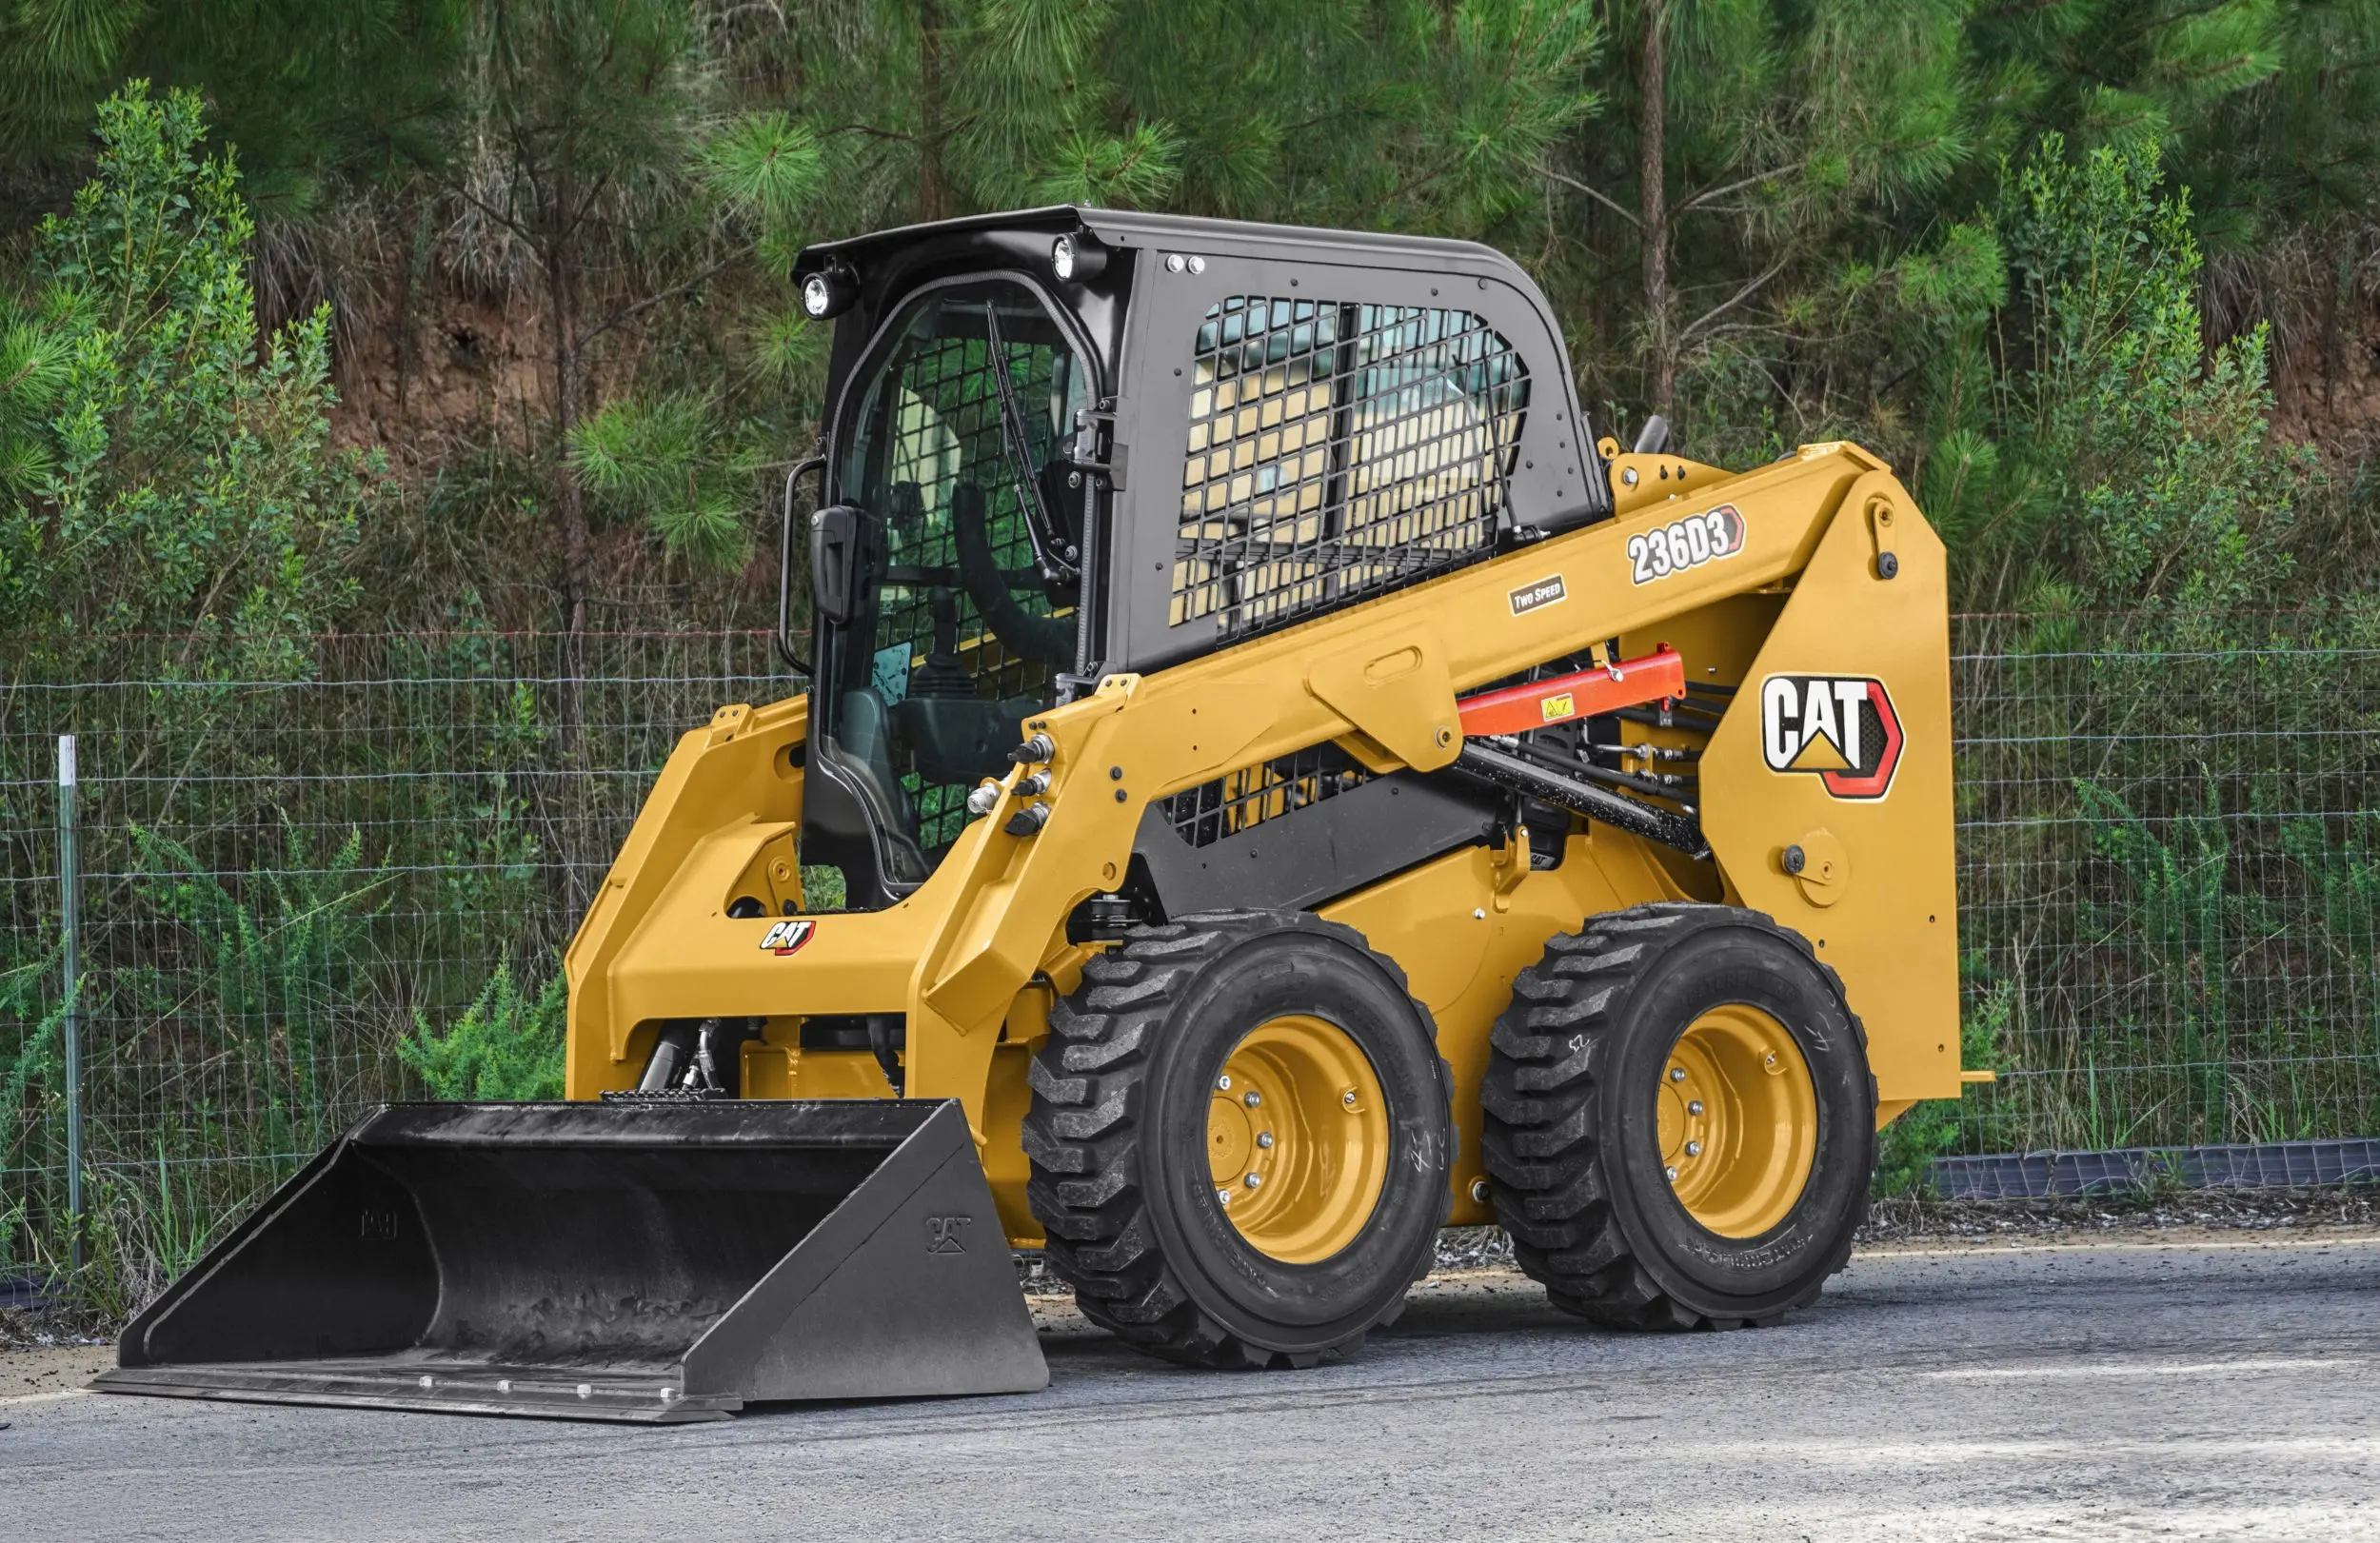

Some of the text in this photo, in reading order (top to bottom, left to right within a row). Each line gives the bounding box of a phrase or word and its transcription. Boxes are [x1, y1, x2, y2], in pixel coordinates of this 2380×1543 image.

[1629, 511, 1729, 583] 236D3
[1514, 583, 1560, 609] TWO SPEED
[1763, 678, 1868, 770] CAT
[761, 920, 812, 949] CAT
[926, 1217, 971, 1255] CAT
